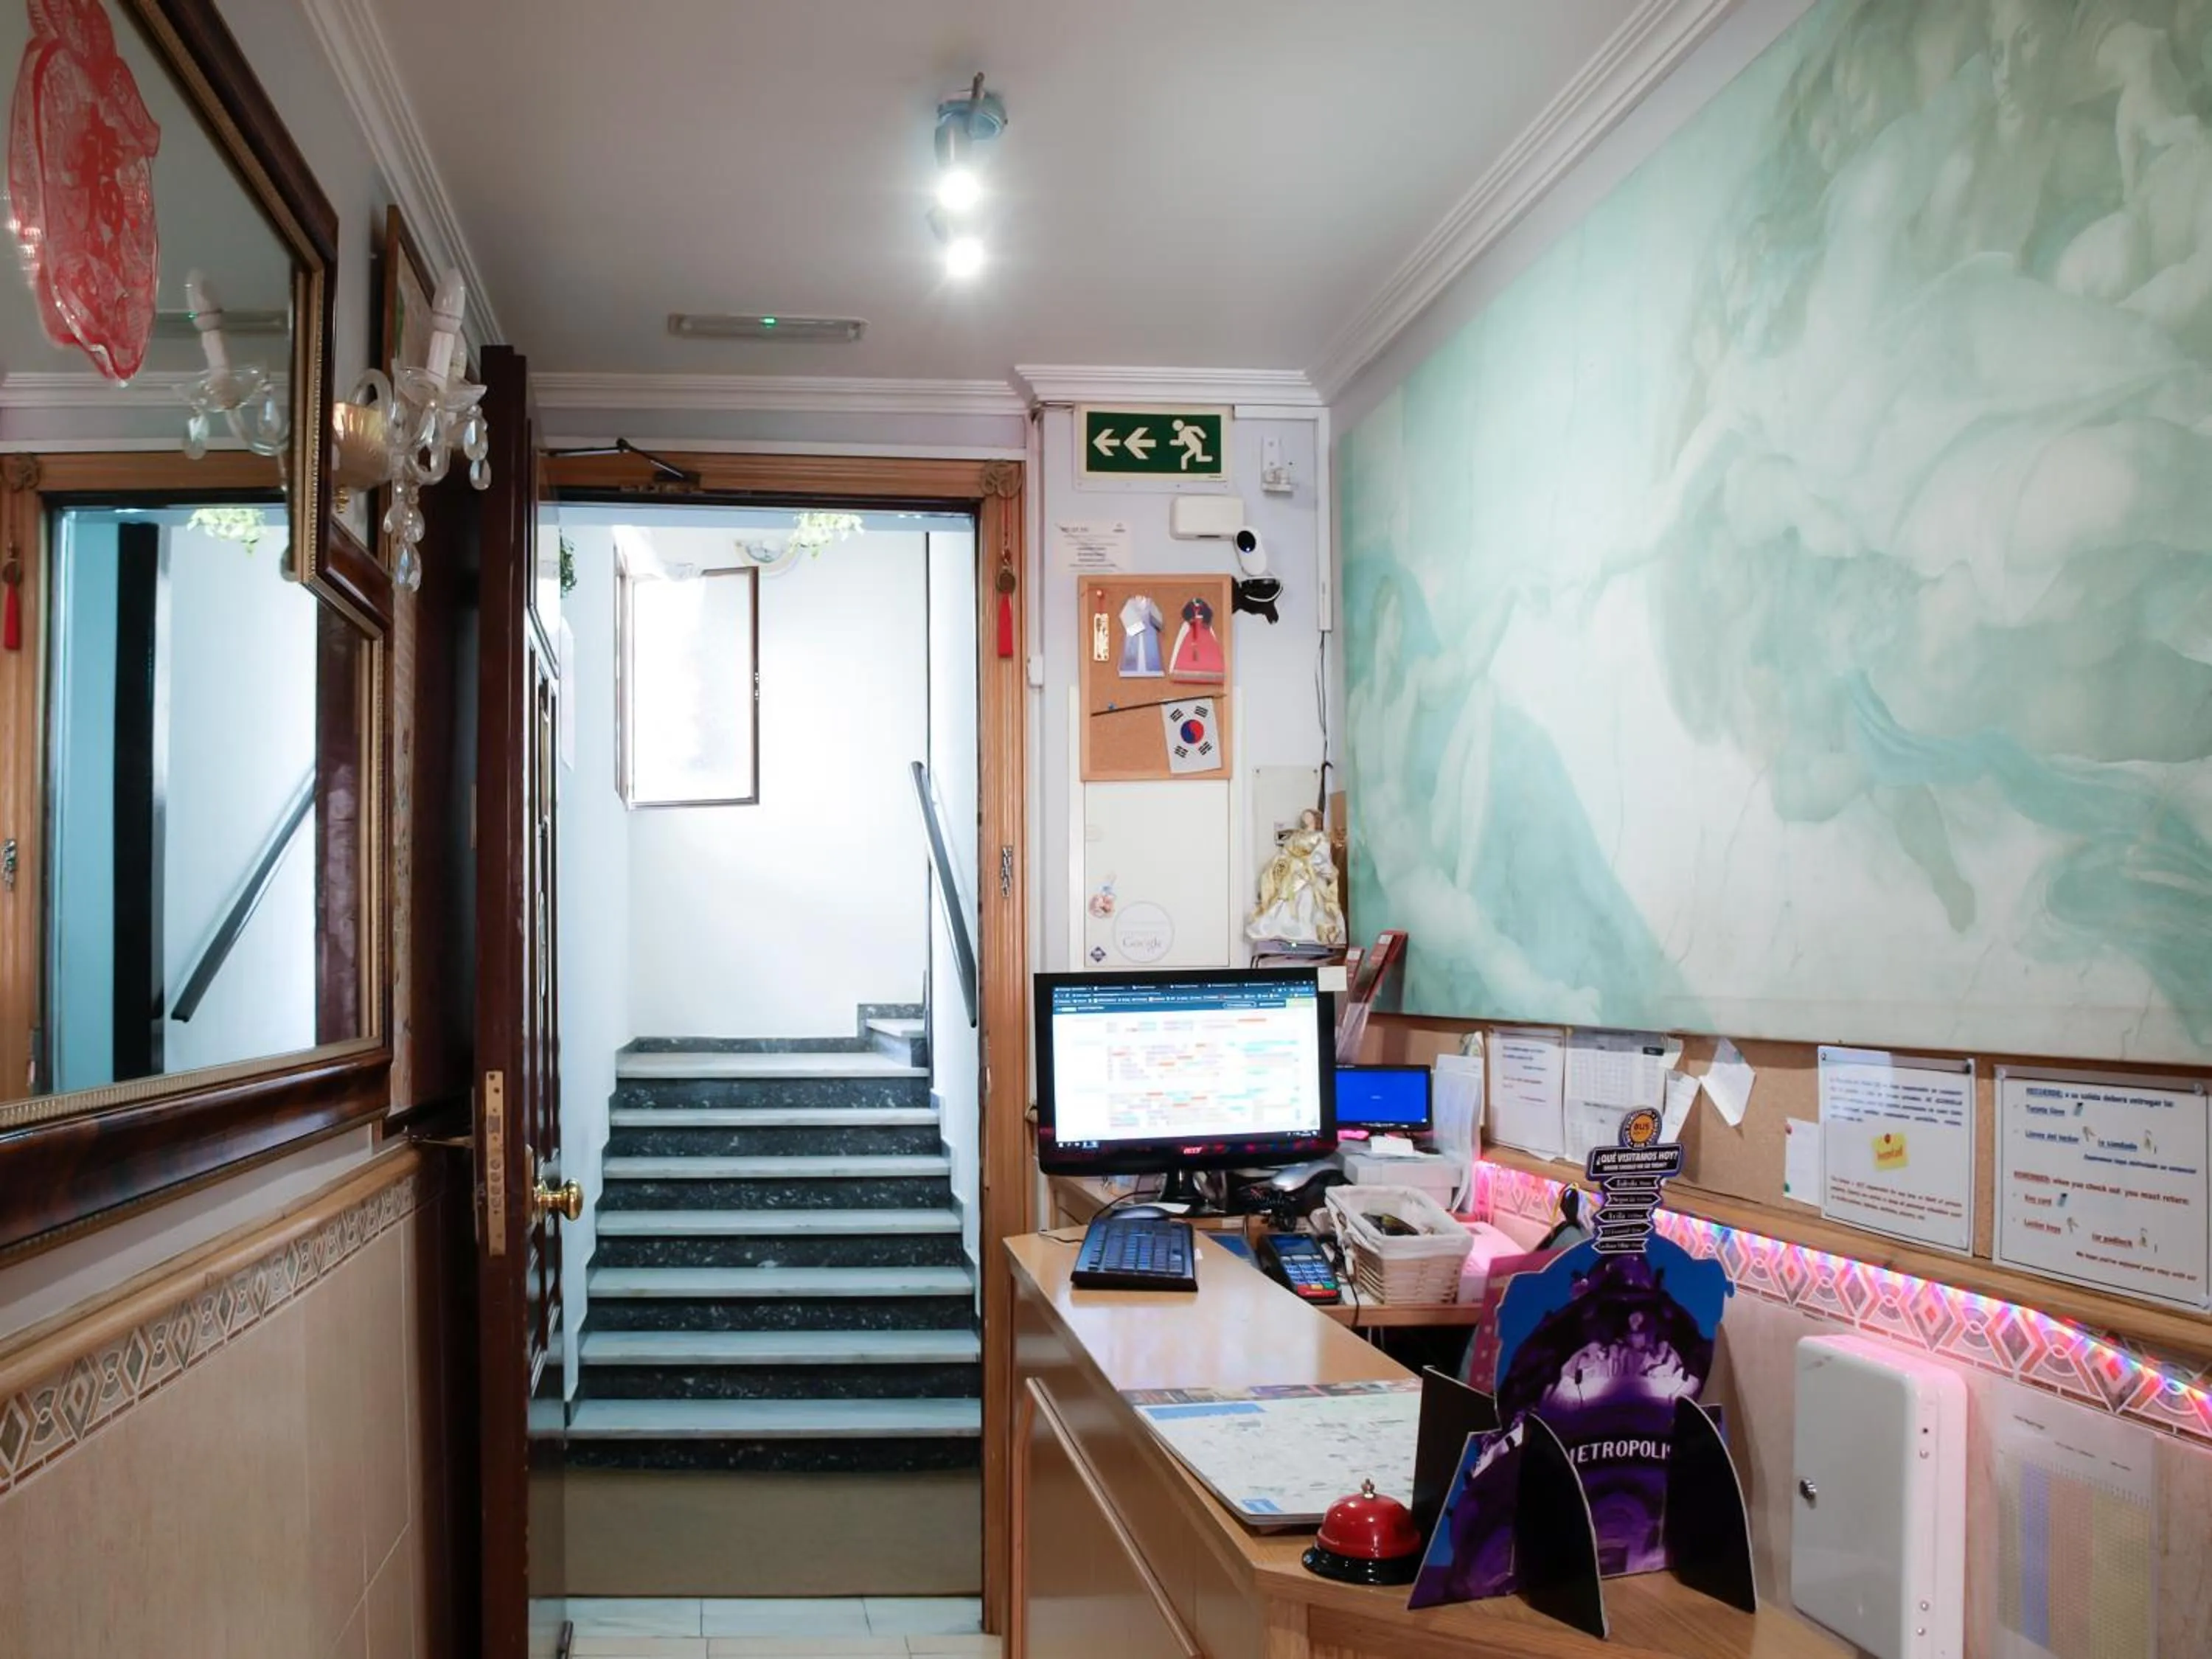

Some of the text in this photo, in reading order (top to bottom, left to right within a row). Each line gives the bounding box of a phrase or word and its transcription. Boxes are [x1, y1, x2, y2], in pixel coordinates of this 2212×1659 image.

[1618, 1152, 1657, 1163] VISITAMOS
[1658, 1150, 1678, 1161] HOY?
[1569, 1440, 1671, 1464] ETROPOLI
